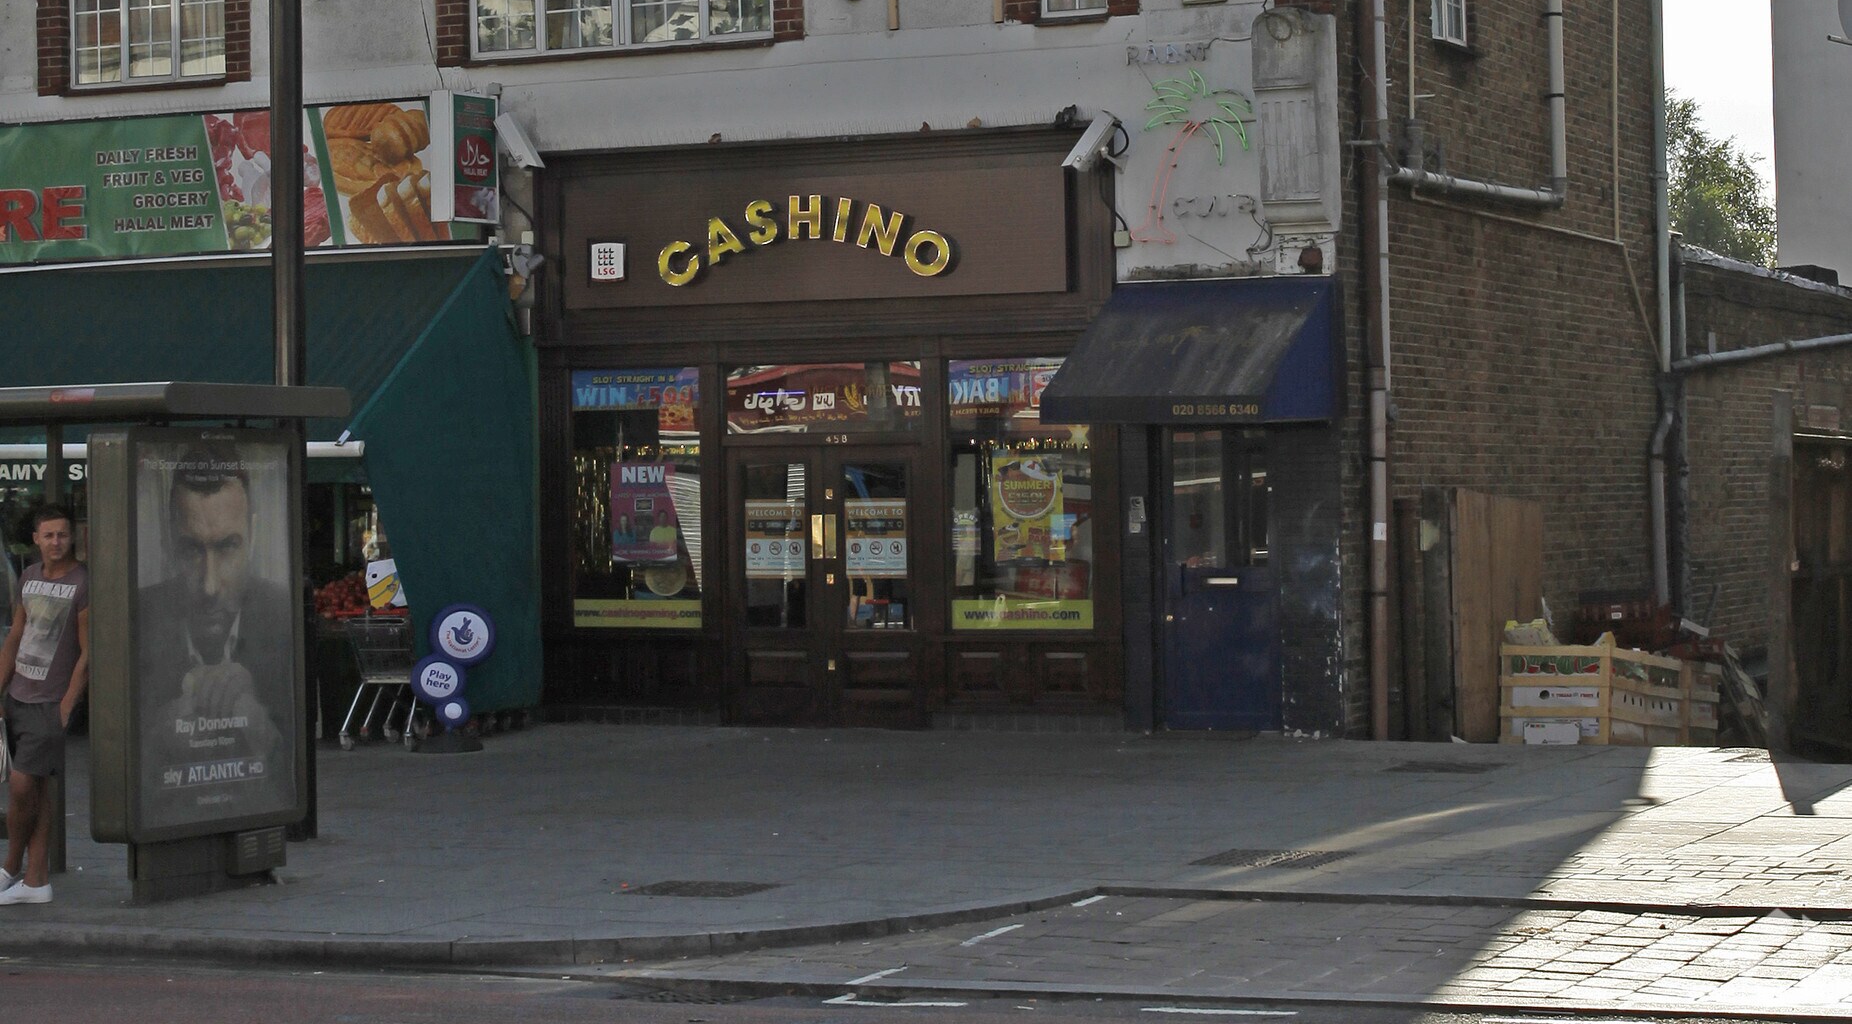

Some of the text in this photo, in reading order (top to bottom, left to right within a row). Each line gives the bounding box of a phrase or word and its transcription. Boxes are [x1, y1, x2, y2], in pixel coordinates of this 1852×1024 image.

[96, 146, 198, 166] DAILY FRESH
[102, 168, 204, 189] FRUIT & VEG
[133, 191, 210, 209] GROCERY
[114, 214, 215, 233] HALAL MEAT
[658, 194, 951, 287] CASHINO
[598, 268, 616, 276] LSG
[576, 385, 627, 407] WIN
[1172, 403, 1259, 416] 020 8566 6340
[825, 435, 848, 444] 458
[621, 465, 665, 484] NEW
[1003, 480, 1053, 490] SUMMER
[748, 509, 787, 517] WELCOME
[848, 508, 904, 517] WELCOME TO
[963, 607, 1081, 620] wwwcashino.com
[426, 677, 450, 690] here
[429, 669, 452, 683] Play
[175, 716, 249, 736] Ray Donovan
[163, 761, 264, 786] sky ATLANTIC HD
